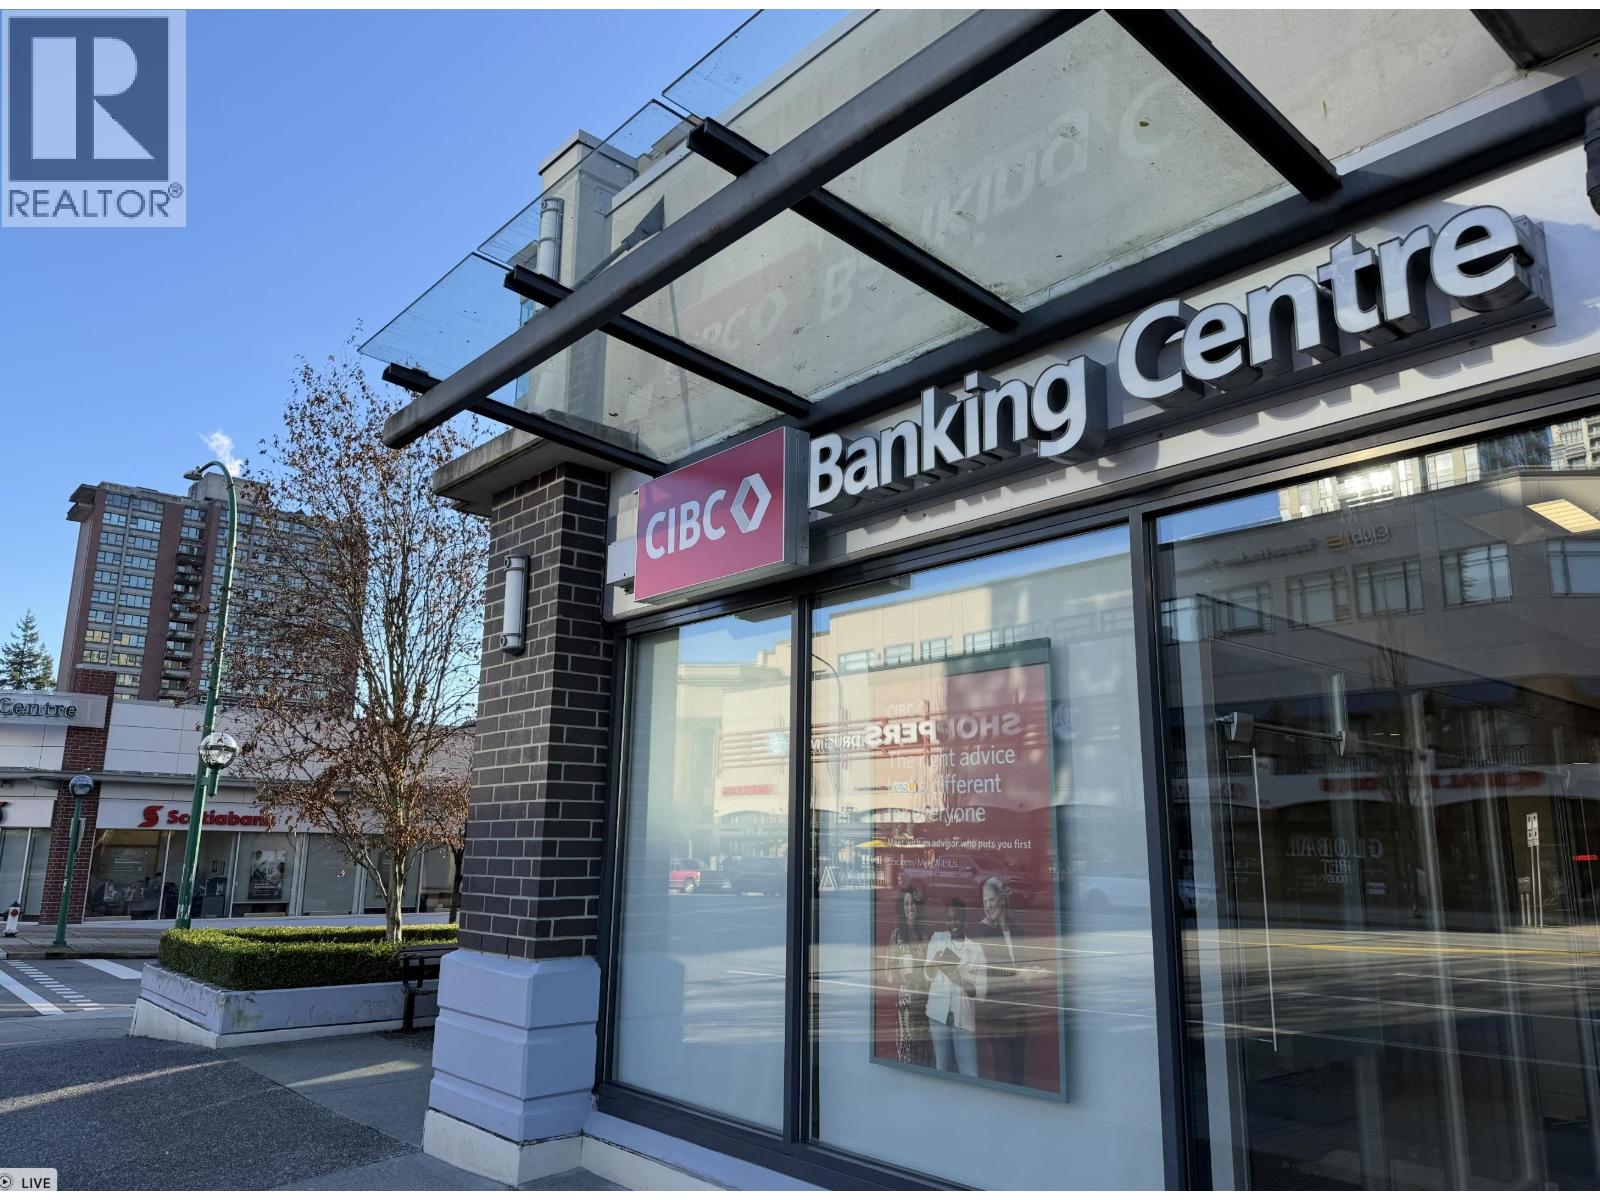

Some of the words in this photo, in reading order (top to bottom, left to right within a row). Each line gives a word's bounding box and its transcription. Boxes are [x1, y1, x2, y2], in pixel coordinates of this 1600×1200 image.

[807, 356, 1087, 510] Banking
[1117, 205, 1519, 400] Centre
[645, 490, 727, 560] CIBC
[0, 697, 77, 718] Centre
[960, 745, 1015, 767] advice
[167, 809, 277, 828] Sctiaban
[888, 838, 904, 848] Meet
[906, 838, 920, 848] with
[932, 838, 959, 848] advisor
[960, 838, 977, 848] who
[978, 839, 995, 850] puts
[997, 841, 1012, 850] you
[1014, 839, 1032, 849] first
